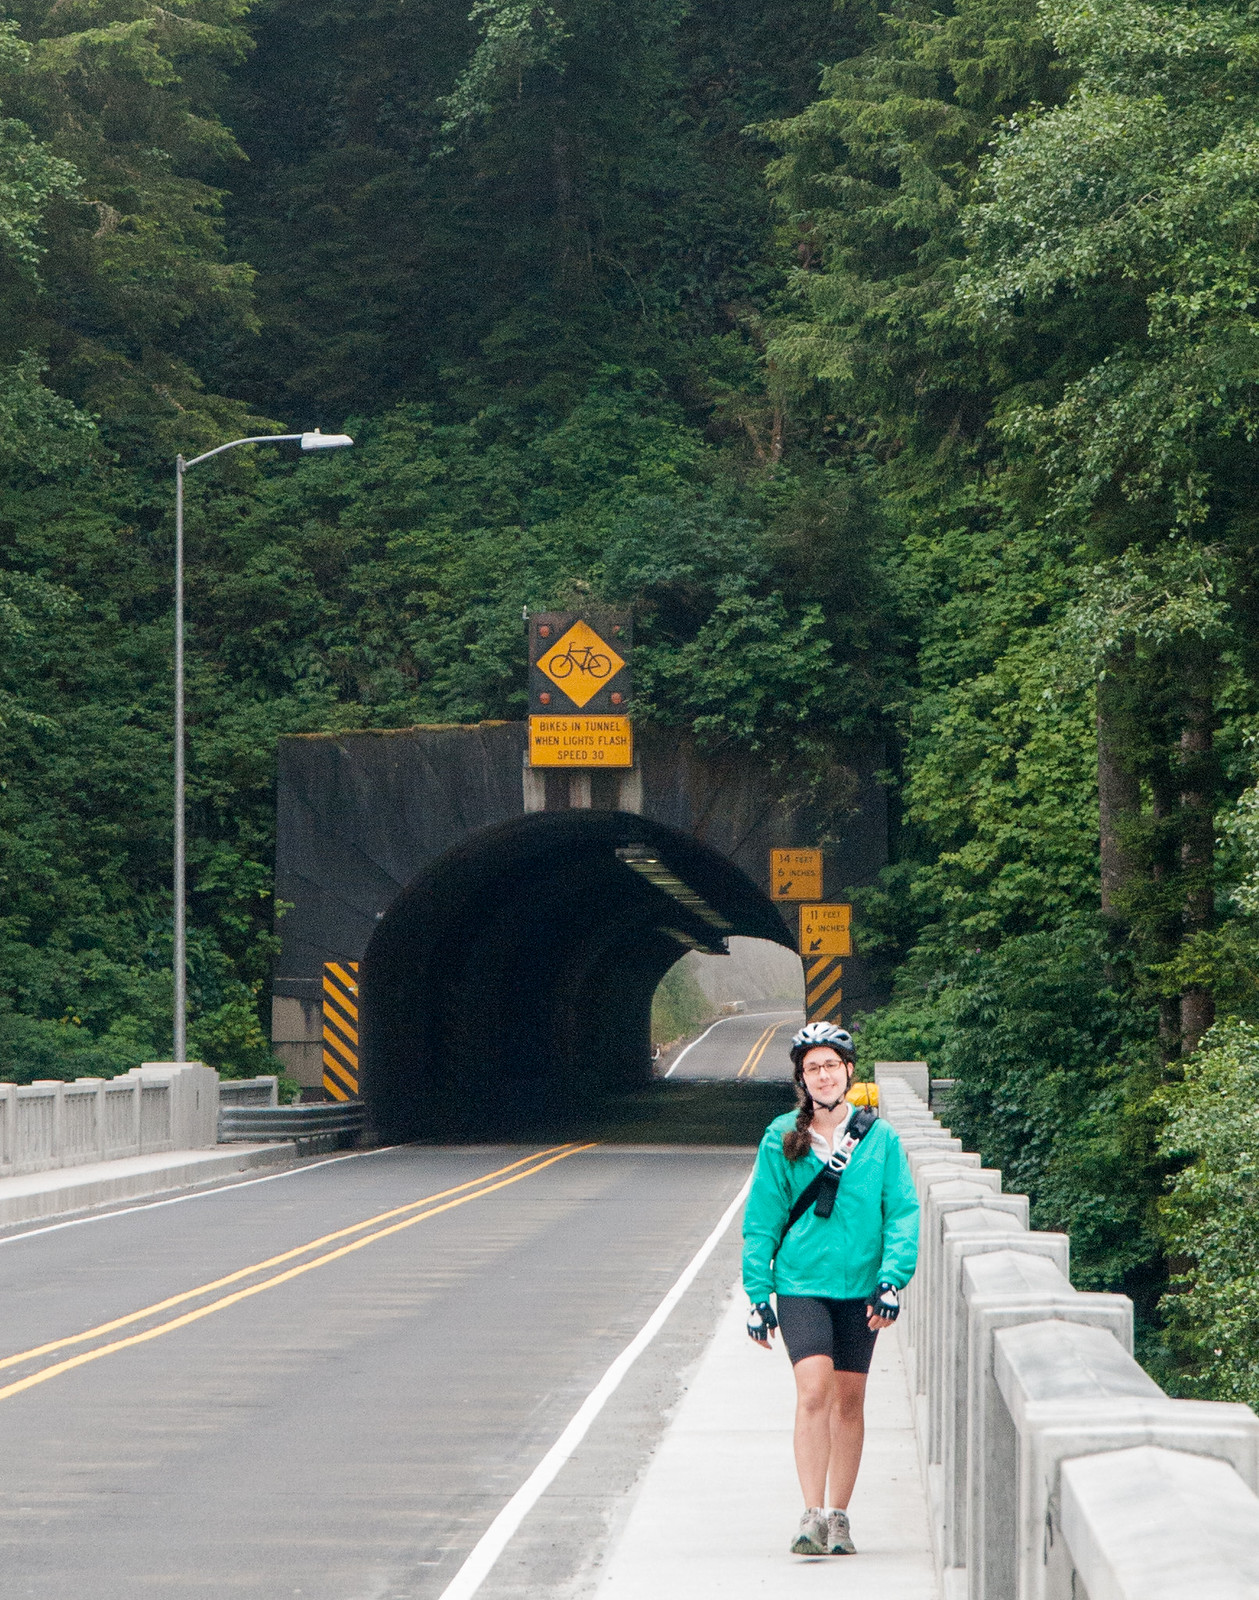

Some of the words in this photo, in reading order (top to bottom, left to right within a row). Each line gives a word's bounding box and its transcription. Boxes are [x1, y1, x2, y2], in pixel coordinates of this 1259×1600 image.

[539, 721, 568, 732] BIKES
[571, 721, 581, 732] IN
[585, 721, 621, 732] TUNNEL
[535, 735, 560, 746] WHEN
[563, 735, 595, 746] LIGHTS
[598, 735, 627, 746] FLASH
[557, 749, 588, 760] SPEED
[592, 749, 605, 760] 30
[779, 854, 791, 863] 14
[790, 869, 816, 877] INCHES
[811, 910, 818, 920] 11
[823, 910, 841, 919] FEET
[806, 924, 813, 934] 6
[817, 924, 846, 932] INCHES
